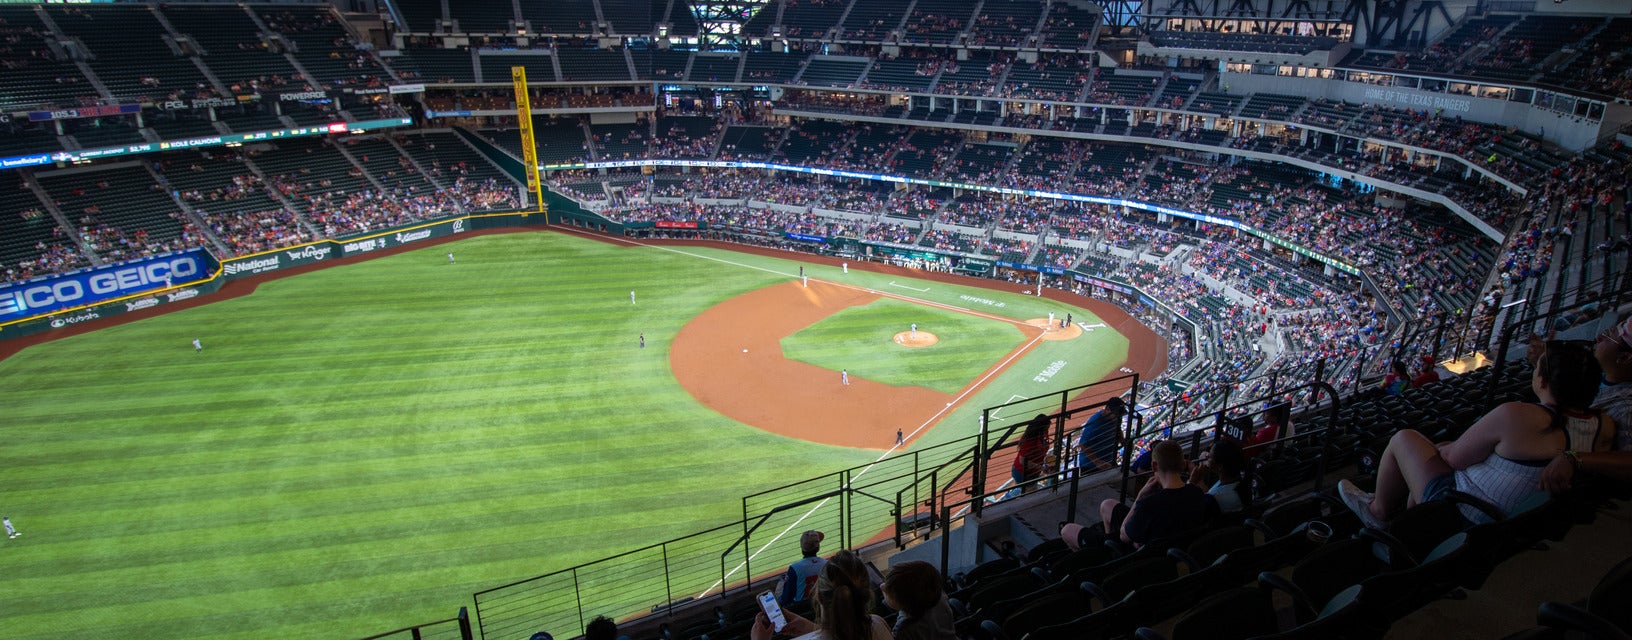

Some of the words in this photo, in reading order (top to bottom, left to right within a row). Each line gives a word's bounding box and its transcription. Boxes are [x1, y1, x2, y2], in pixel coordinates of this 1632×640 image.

[280, 91, 326, 101] POWERADE
[1365, 88, 1384, 98] HOME
[1385, 91, 1394, 101] OF
[1396, 92, 1409, 103] THE
[1410, 94, 1432, 107] TEXAS
[1434, 97, 1470, 112] RANGERS
[51, 110, 77, 119] 105.3
[189, 137, 221, 146] CALHOUN
[302, 246, 331, 260] Kroger
[237, 256, 279, 272] National
[89, 257, 197, 294] GEICO
[0, 279, 83, 315] EICO
[66, 312, 99, 324] Kubota
[1227, 424, 1244, 440] 301
